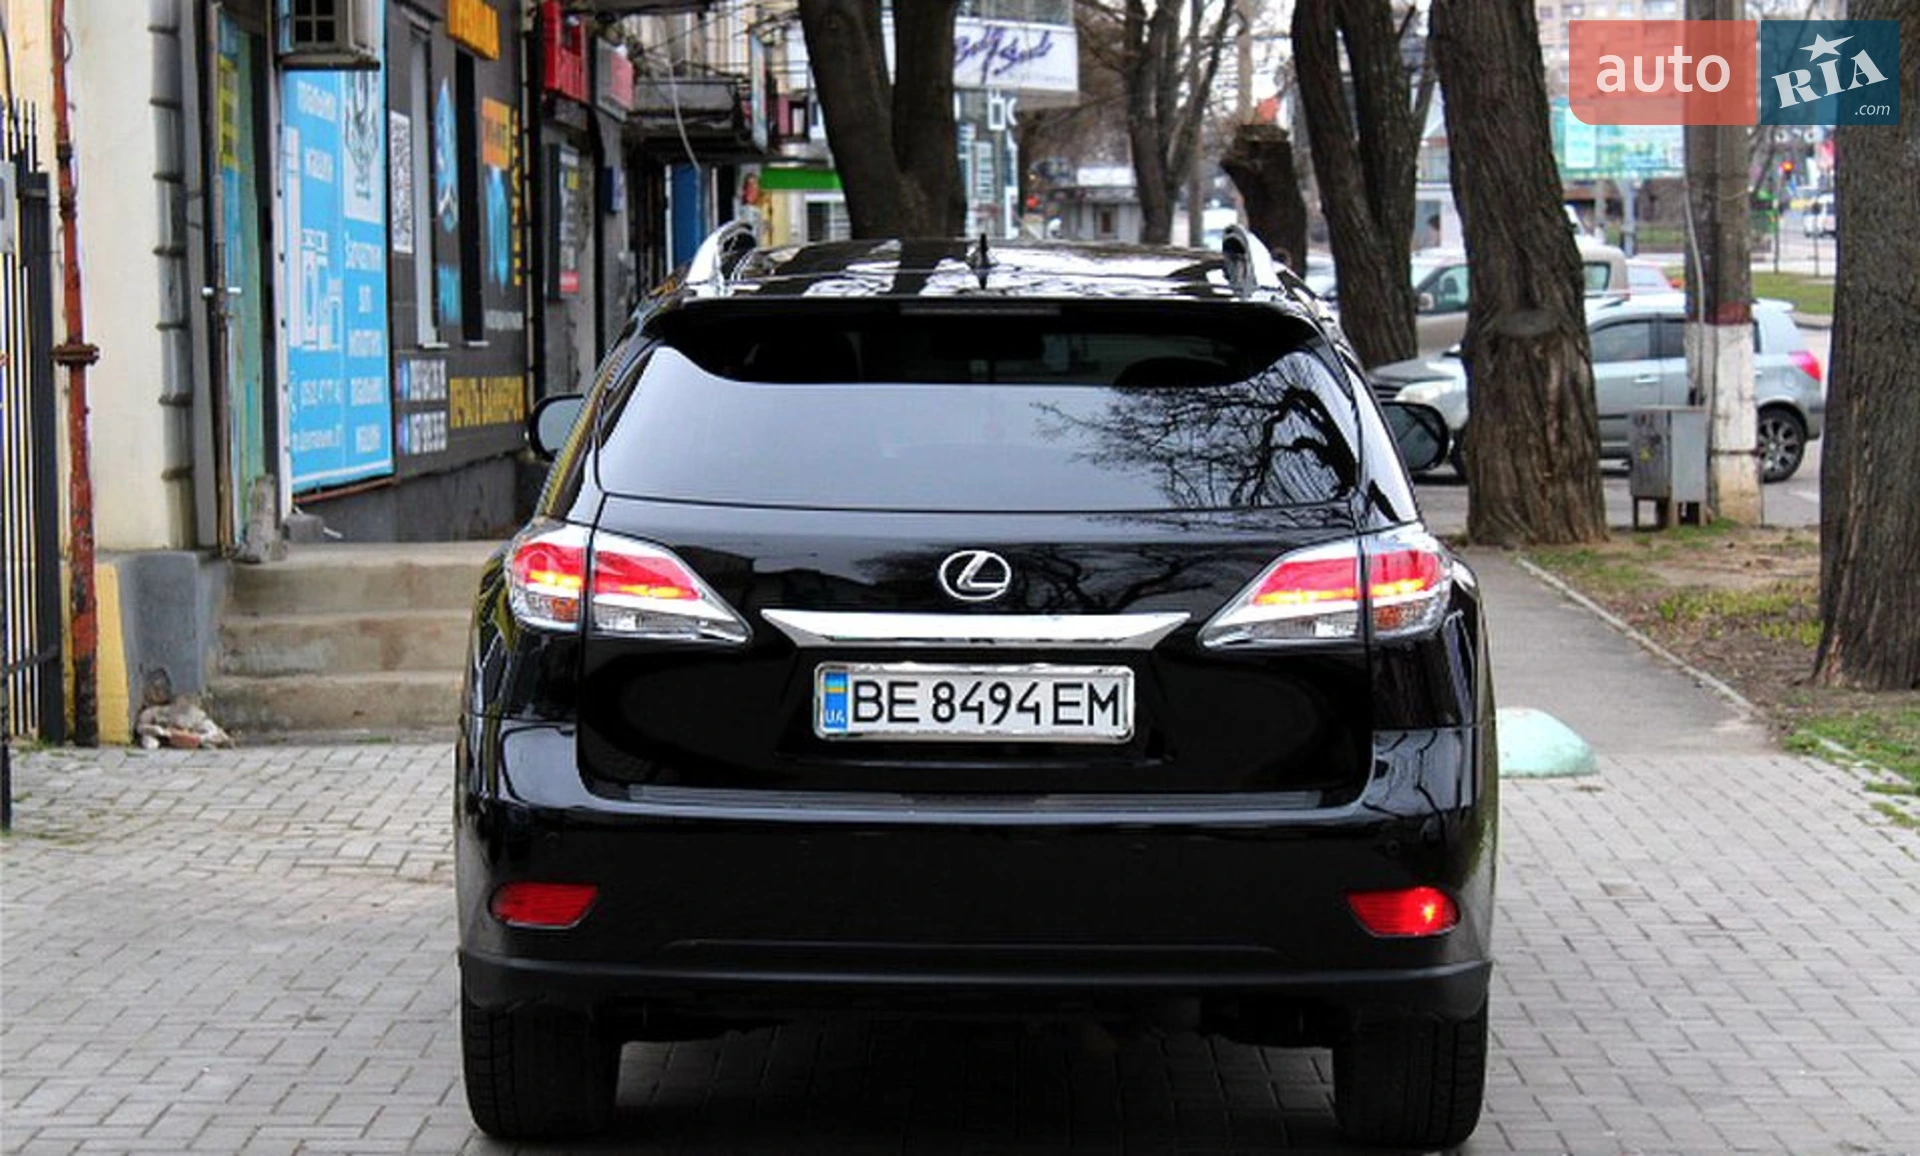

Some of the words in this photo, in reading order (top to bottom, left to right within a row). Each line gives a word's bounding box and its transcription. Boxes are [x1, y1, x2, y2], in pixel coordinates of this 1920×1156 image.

[825, 709, 846, 724] UA
[852, 681, 920, 724] BE
[932, 681, 1041, 725] 8494
[1052, 683, 1120, 727] EM
